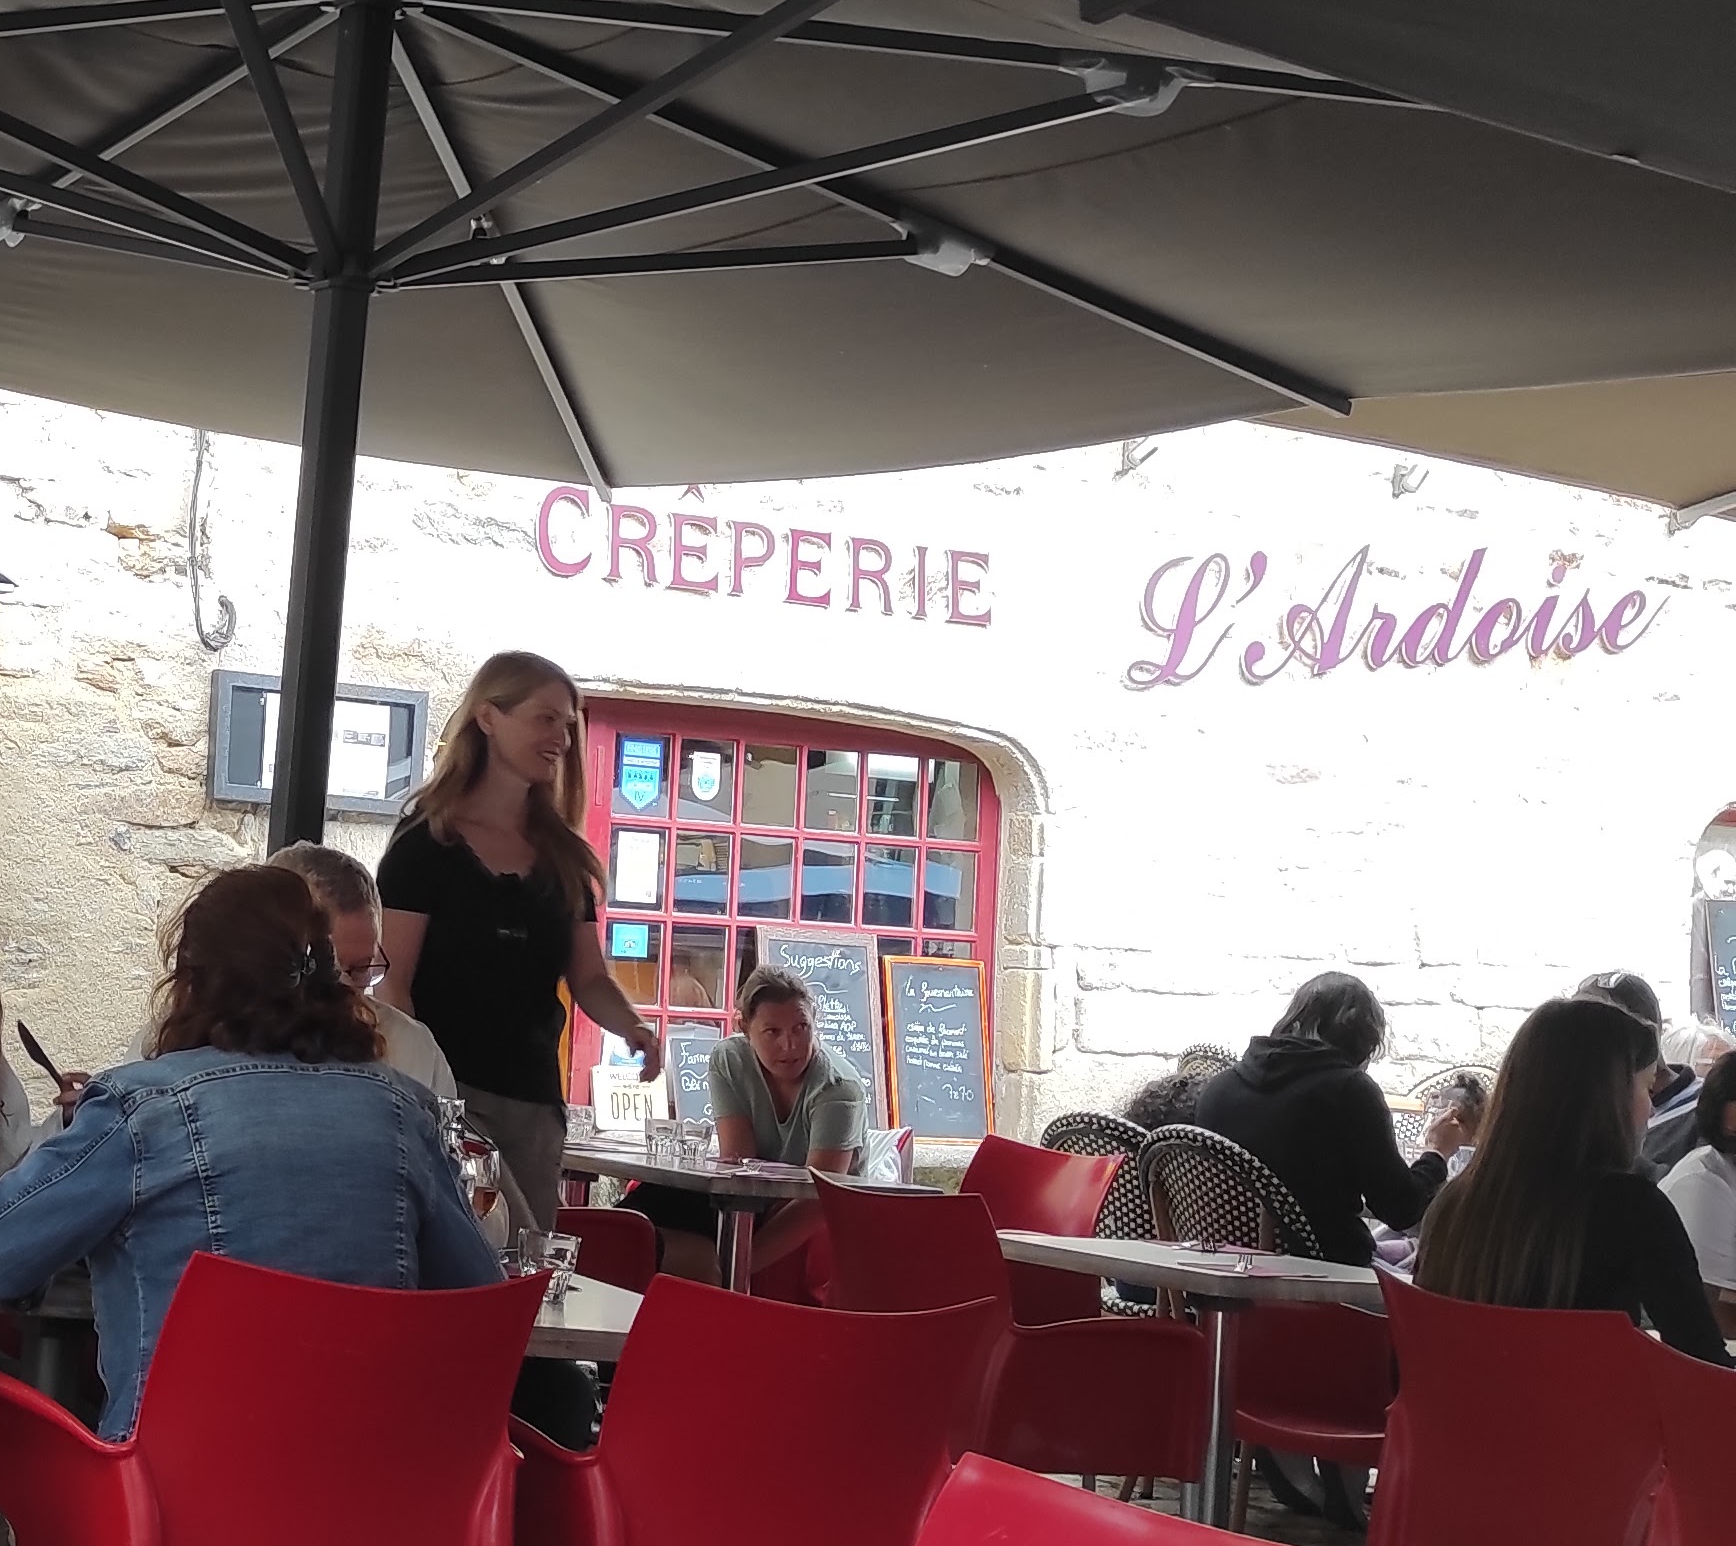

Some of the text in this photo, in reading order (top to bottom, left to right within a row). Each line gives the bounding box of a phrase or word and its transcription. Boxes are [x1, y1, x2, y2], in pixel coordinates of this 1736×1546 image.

[535, 483, 993, 629] CRÊPERIE
[1124, 543, 1670, 691] L'Ardoise
[779, 944, 863, 980] Suggestions
[610, 1091, 654, 1122] OPEN
